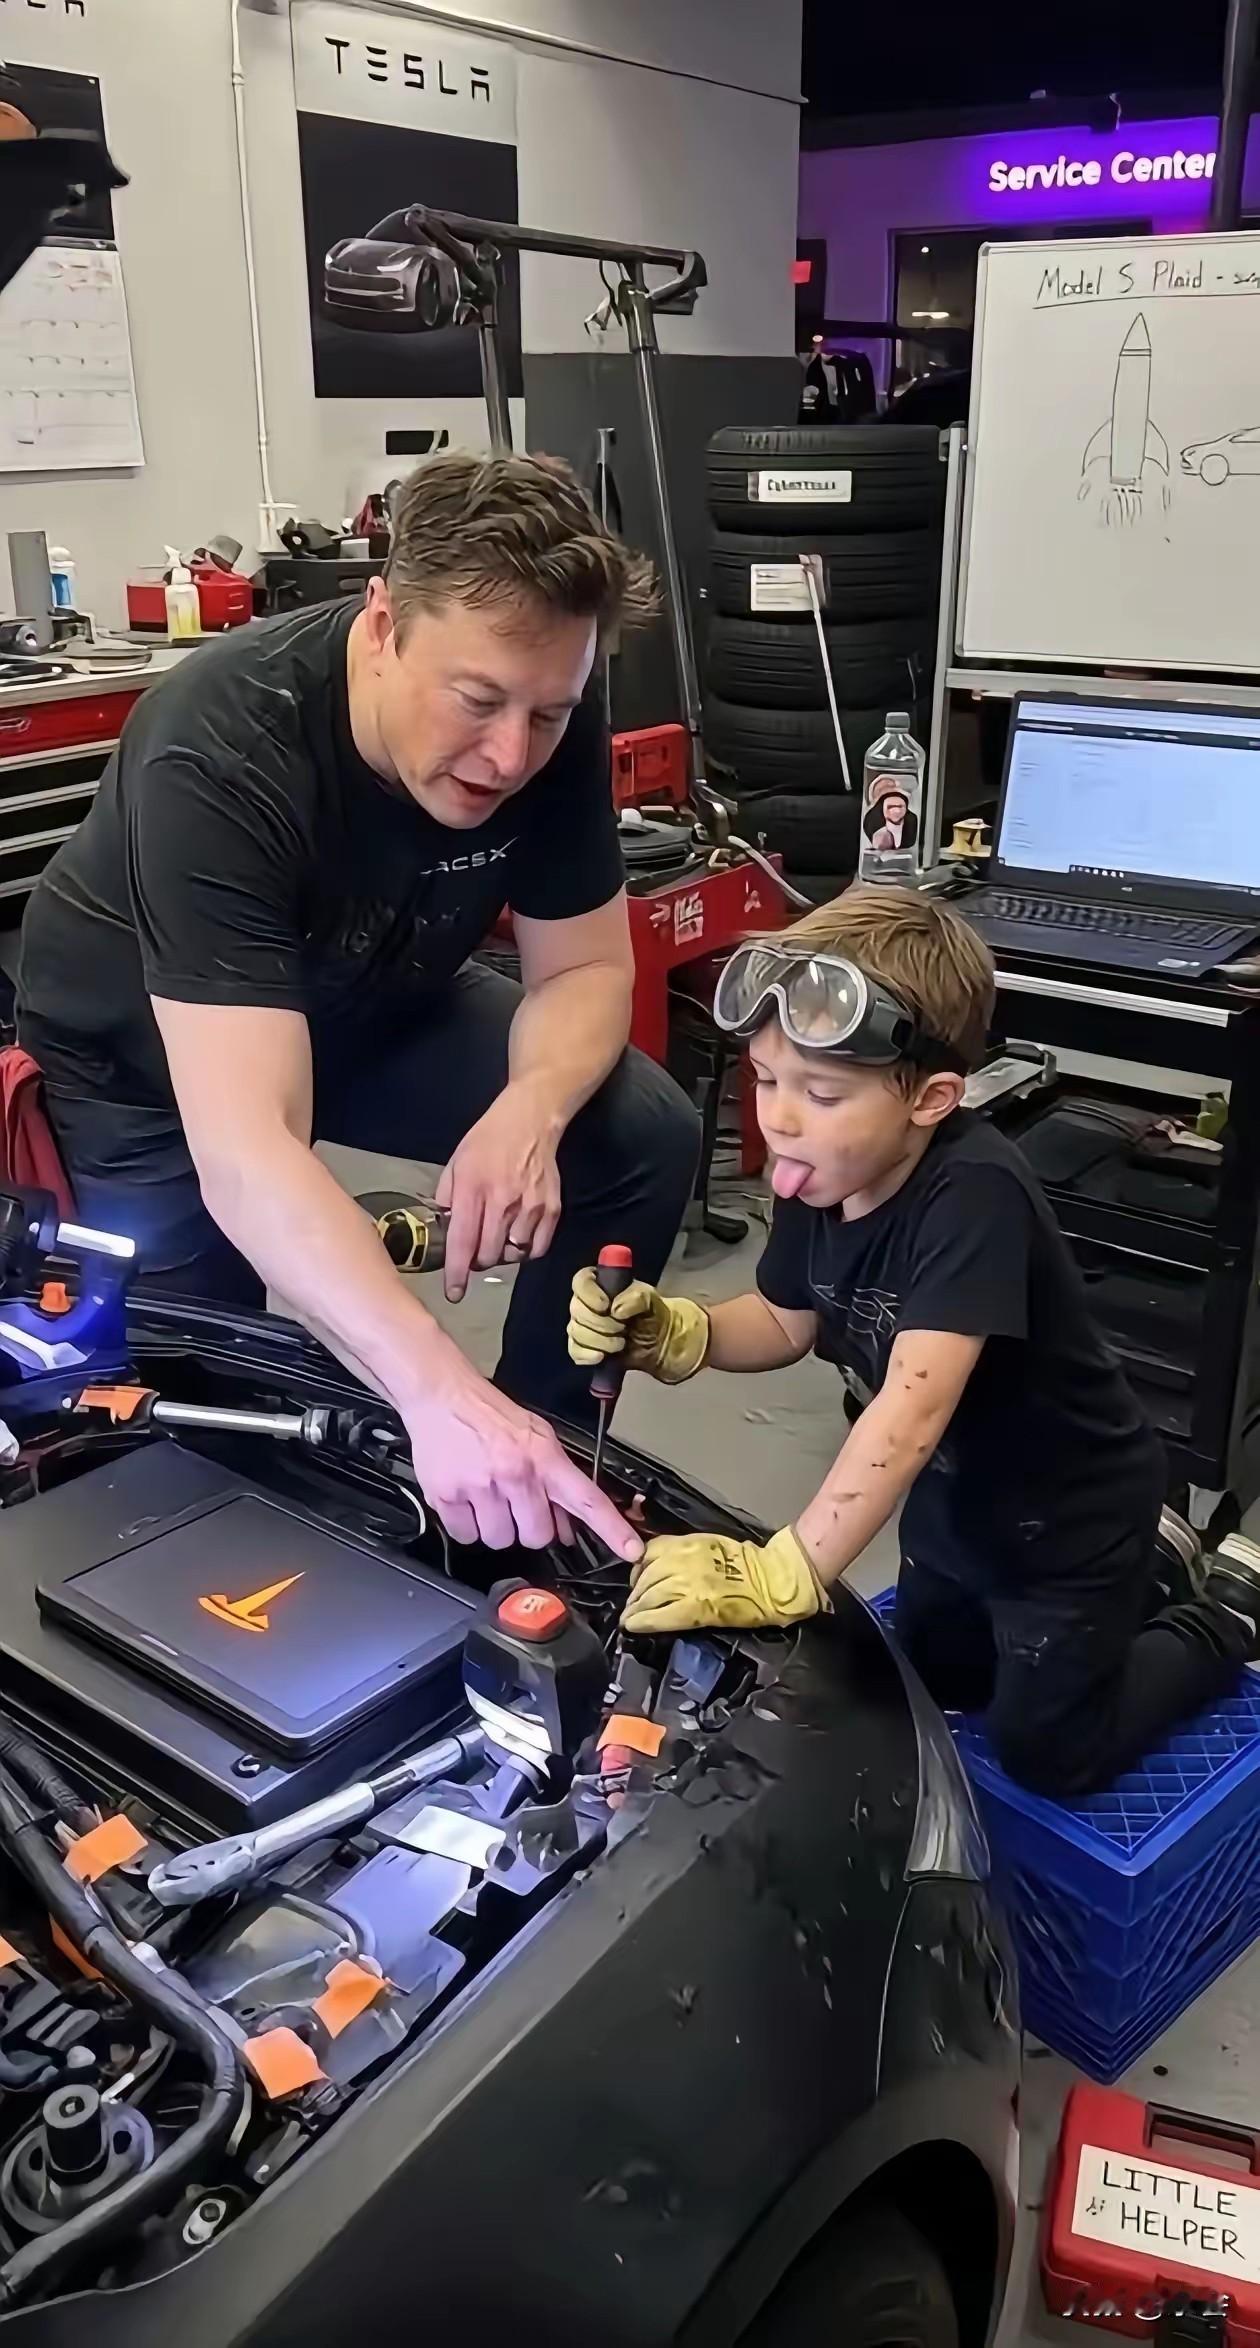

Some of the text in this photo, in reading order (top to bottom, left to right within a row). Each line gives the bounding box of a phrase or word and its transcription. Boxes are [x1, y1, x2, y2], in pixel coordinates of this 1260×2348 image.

[324, 37, 490, 103] TESLA
[988, 150, 1217, 192] Service Center
[1036, 265, 1103, 301] Model
[1118, 262, 1135, 294] S
[1152, 259, 1203, 292] Plaid
[1102, 2160, 1238, 2218] LITTLE
[1120, 2201, 1246, 2261] HELPER
